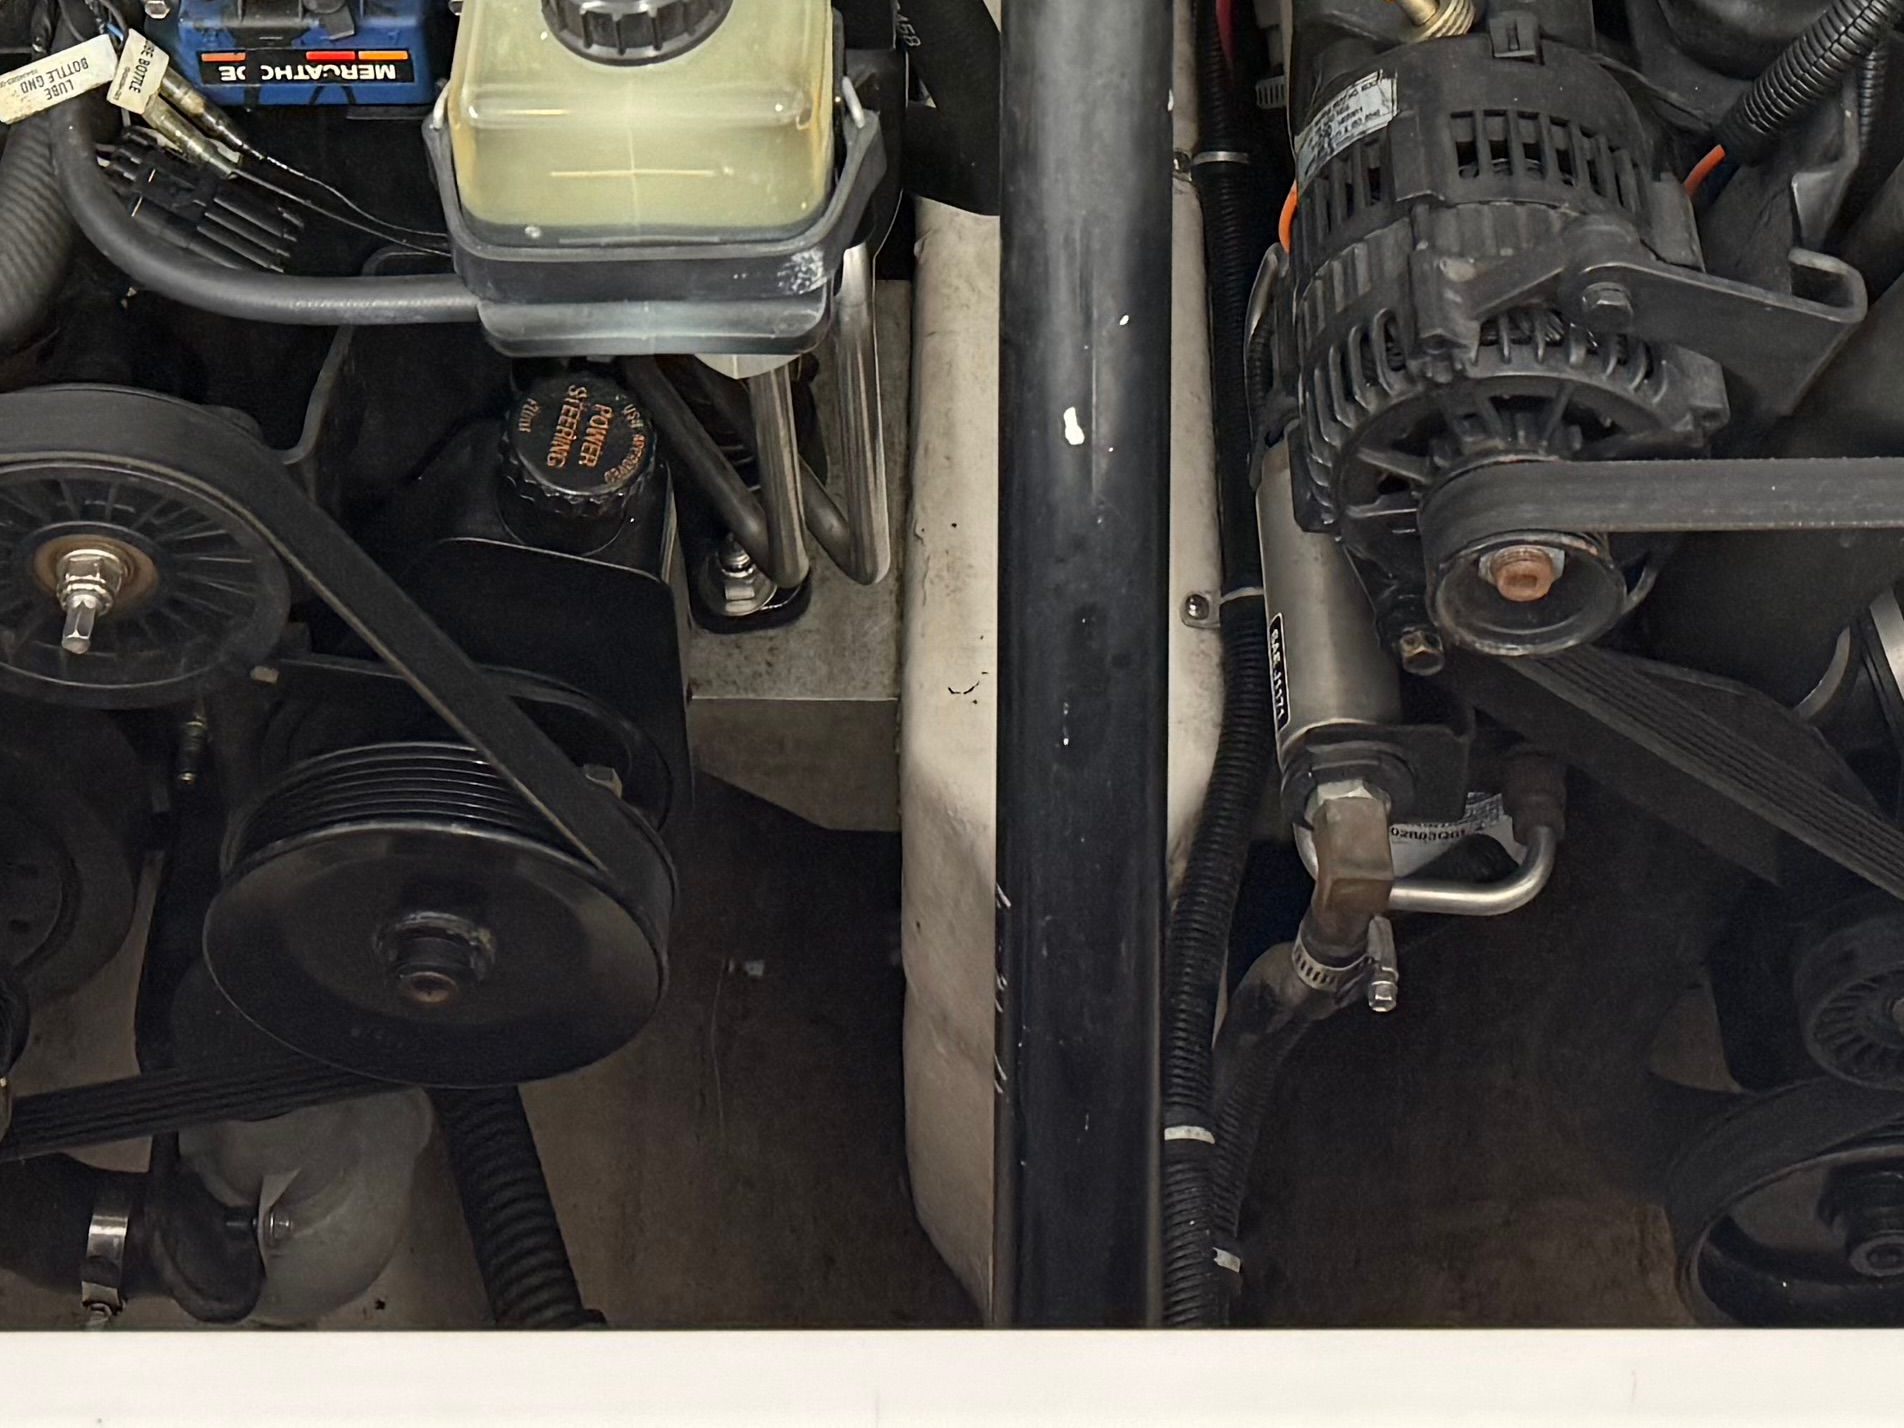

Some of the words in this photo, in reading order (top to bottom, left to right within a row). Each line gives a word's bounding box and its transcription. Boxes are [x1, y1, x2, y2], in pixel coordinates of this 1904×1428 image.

[20, 75, 46, 94] GND
[48, 57, 89, 79] BOTTLE
[129, 58, 150, 94] BOTTLE
[46, 79, 75, 101] LUBE
[546, 384, 589, 469] STEERING
[578, 403, 615, 468] POWER
[1270, 627, 1282, 668] SAE
